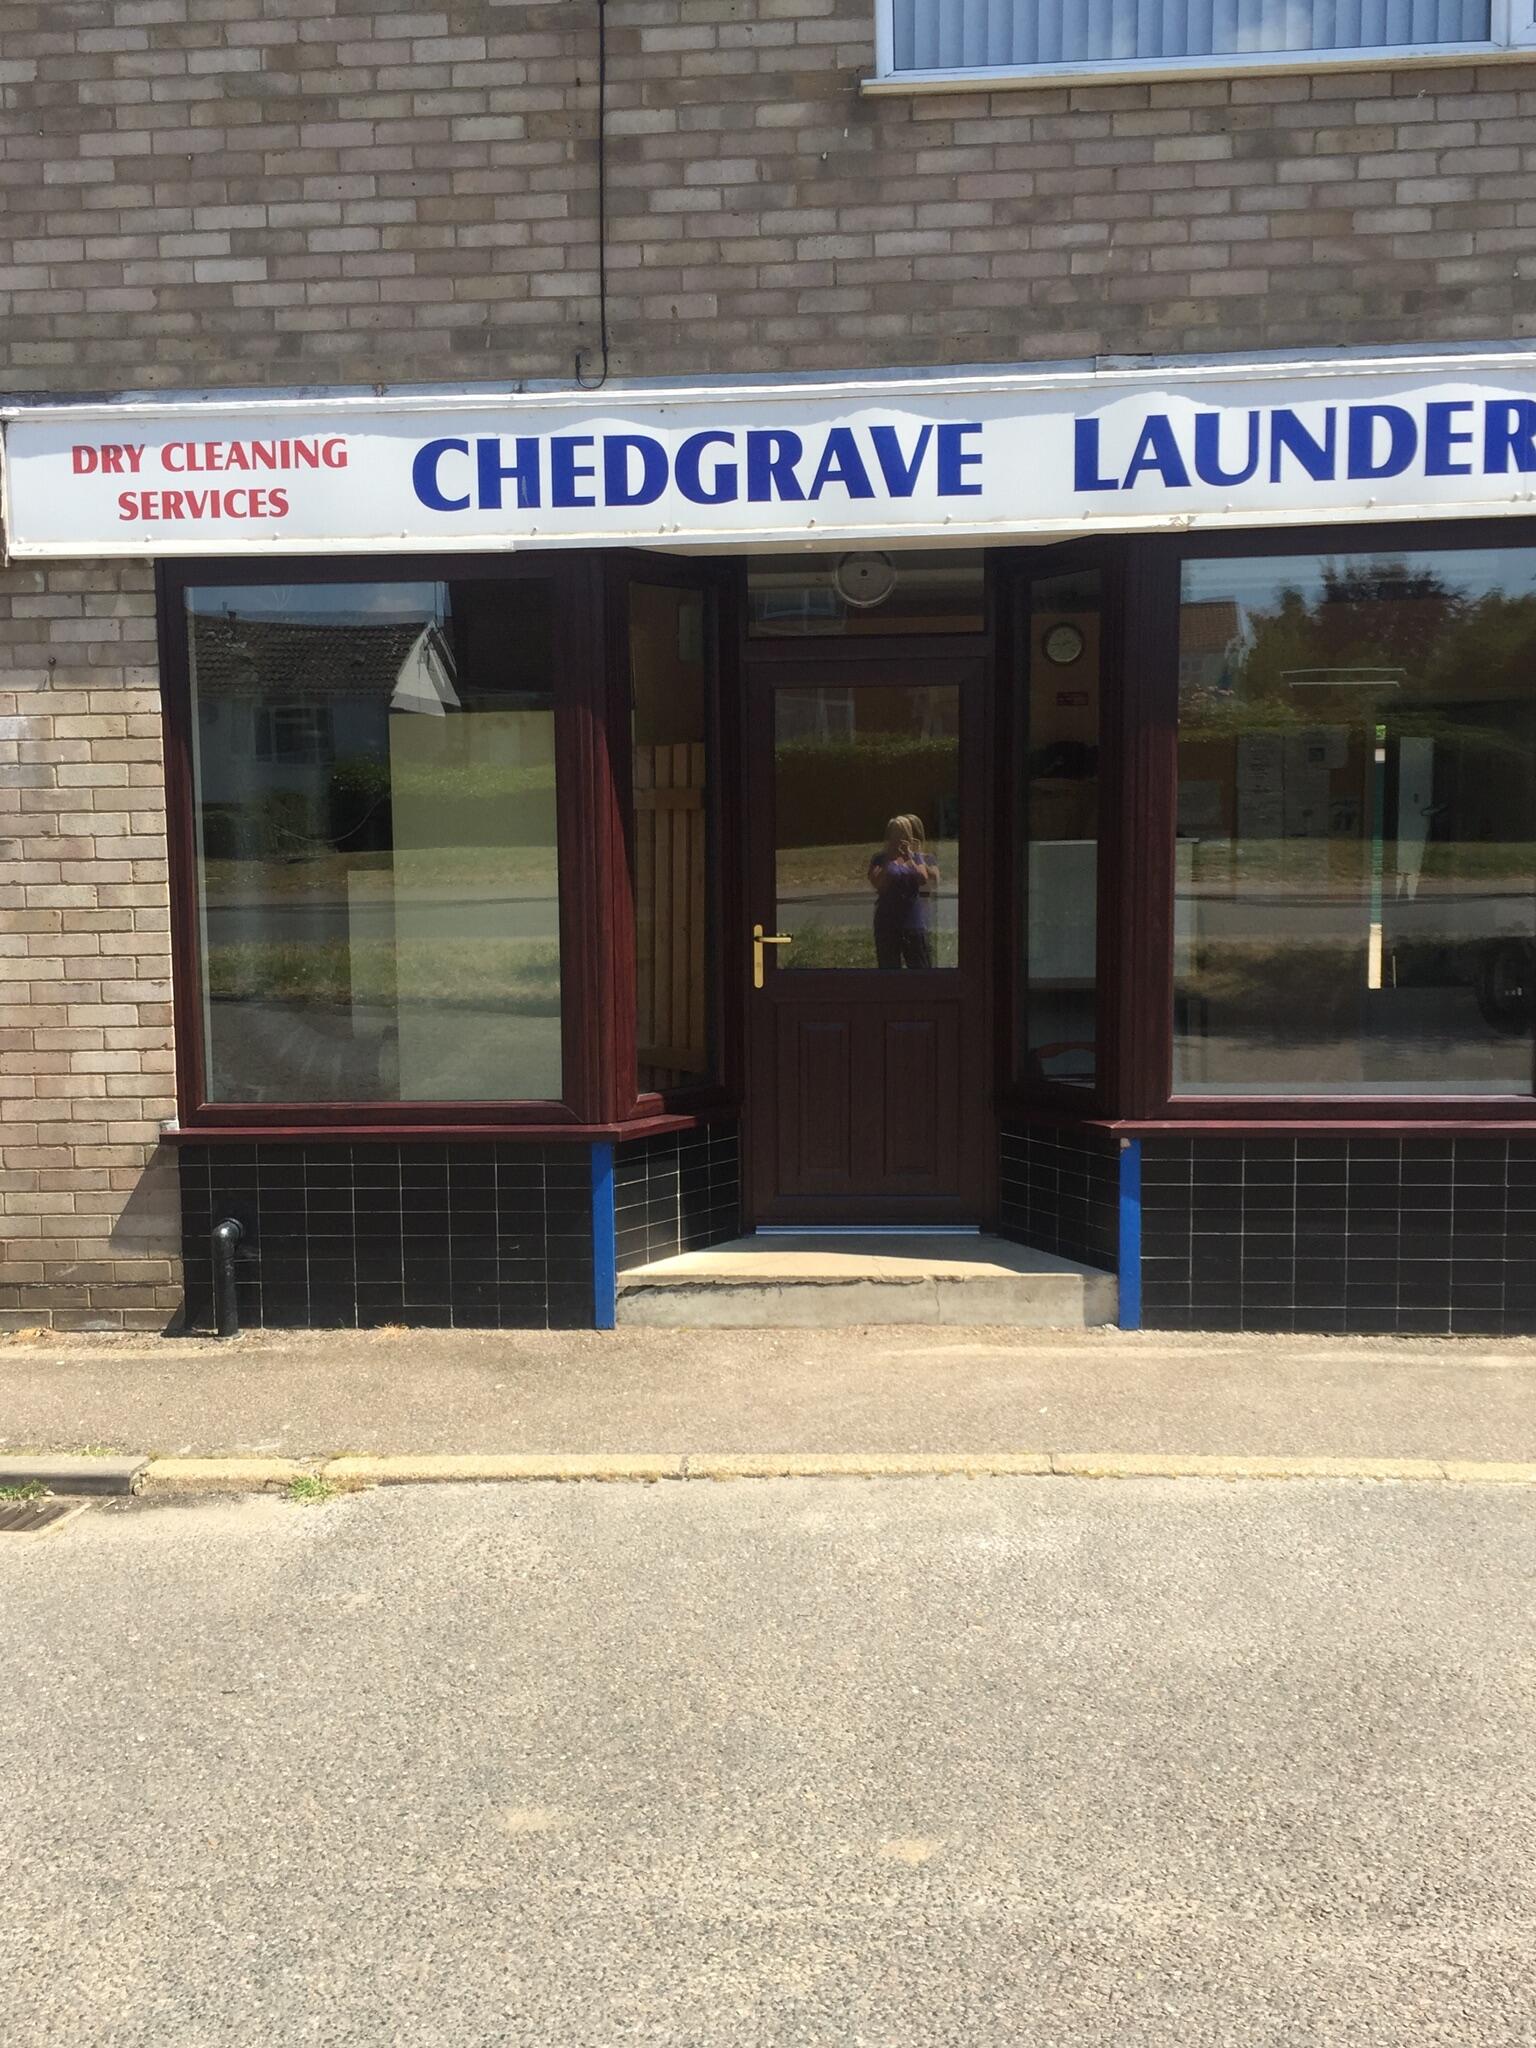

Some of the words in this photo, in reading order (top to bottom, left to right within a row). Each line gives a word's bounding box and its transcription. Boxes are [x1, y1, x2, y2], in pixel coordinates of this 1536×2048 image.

[72, 444, 146, 474] DRY
[161, 438, 349, 473] CLEANING
[412, 422, 983, 512] CHEDGRAVE
[1074, 399, 1536, 492] LAUNDER
[118, 488, 290, 521] SERVICES
